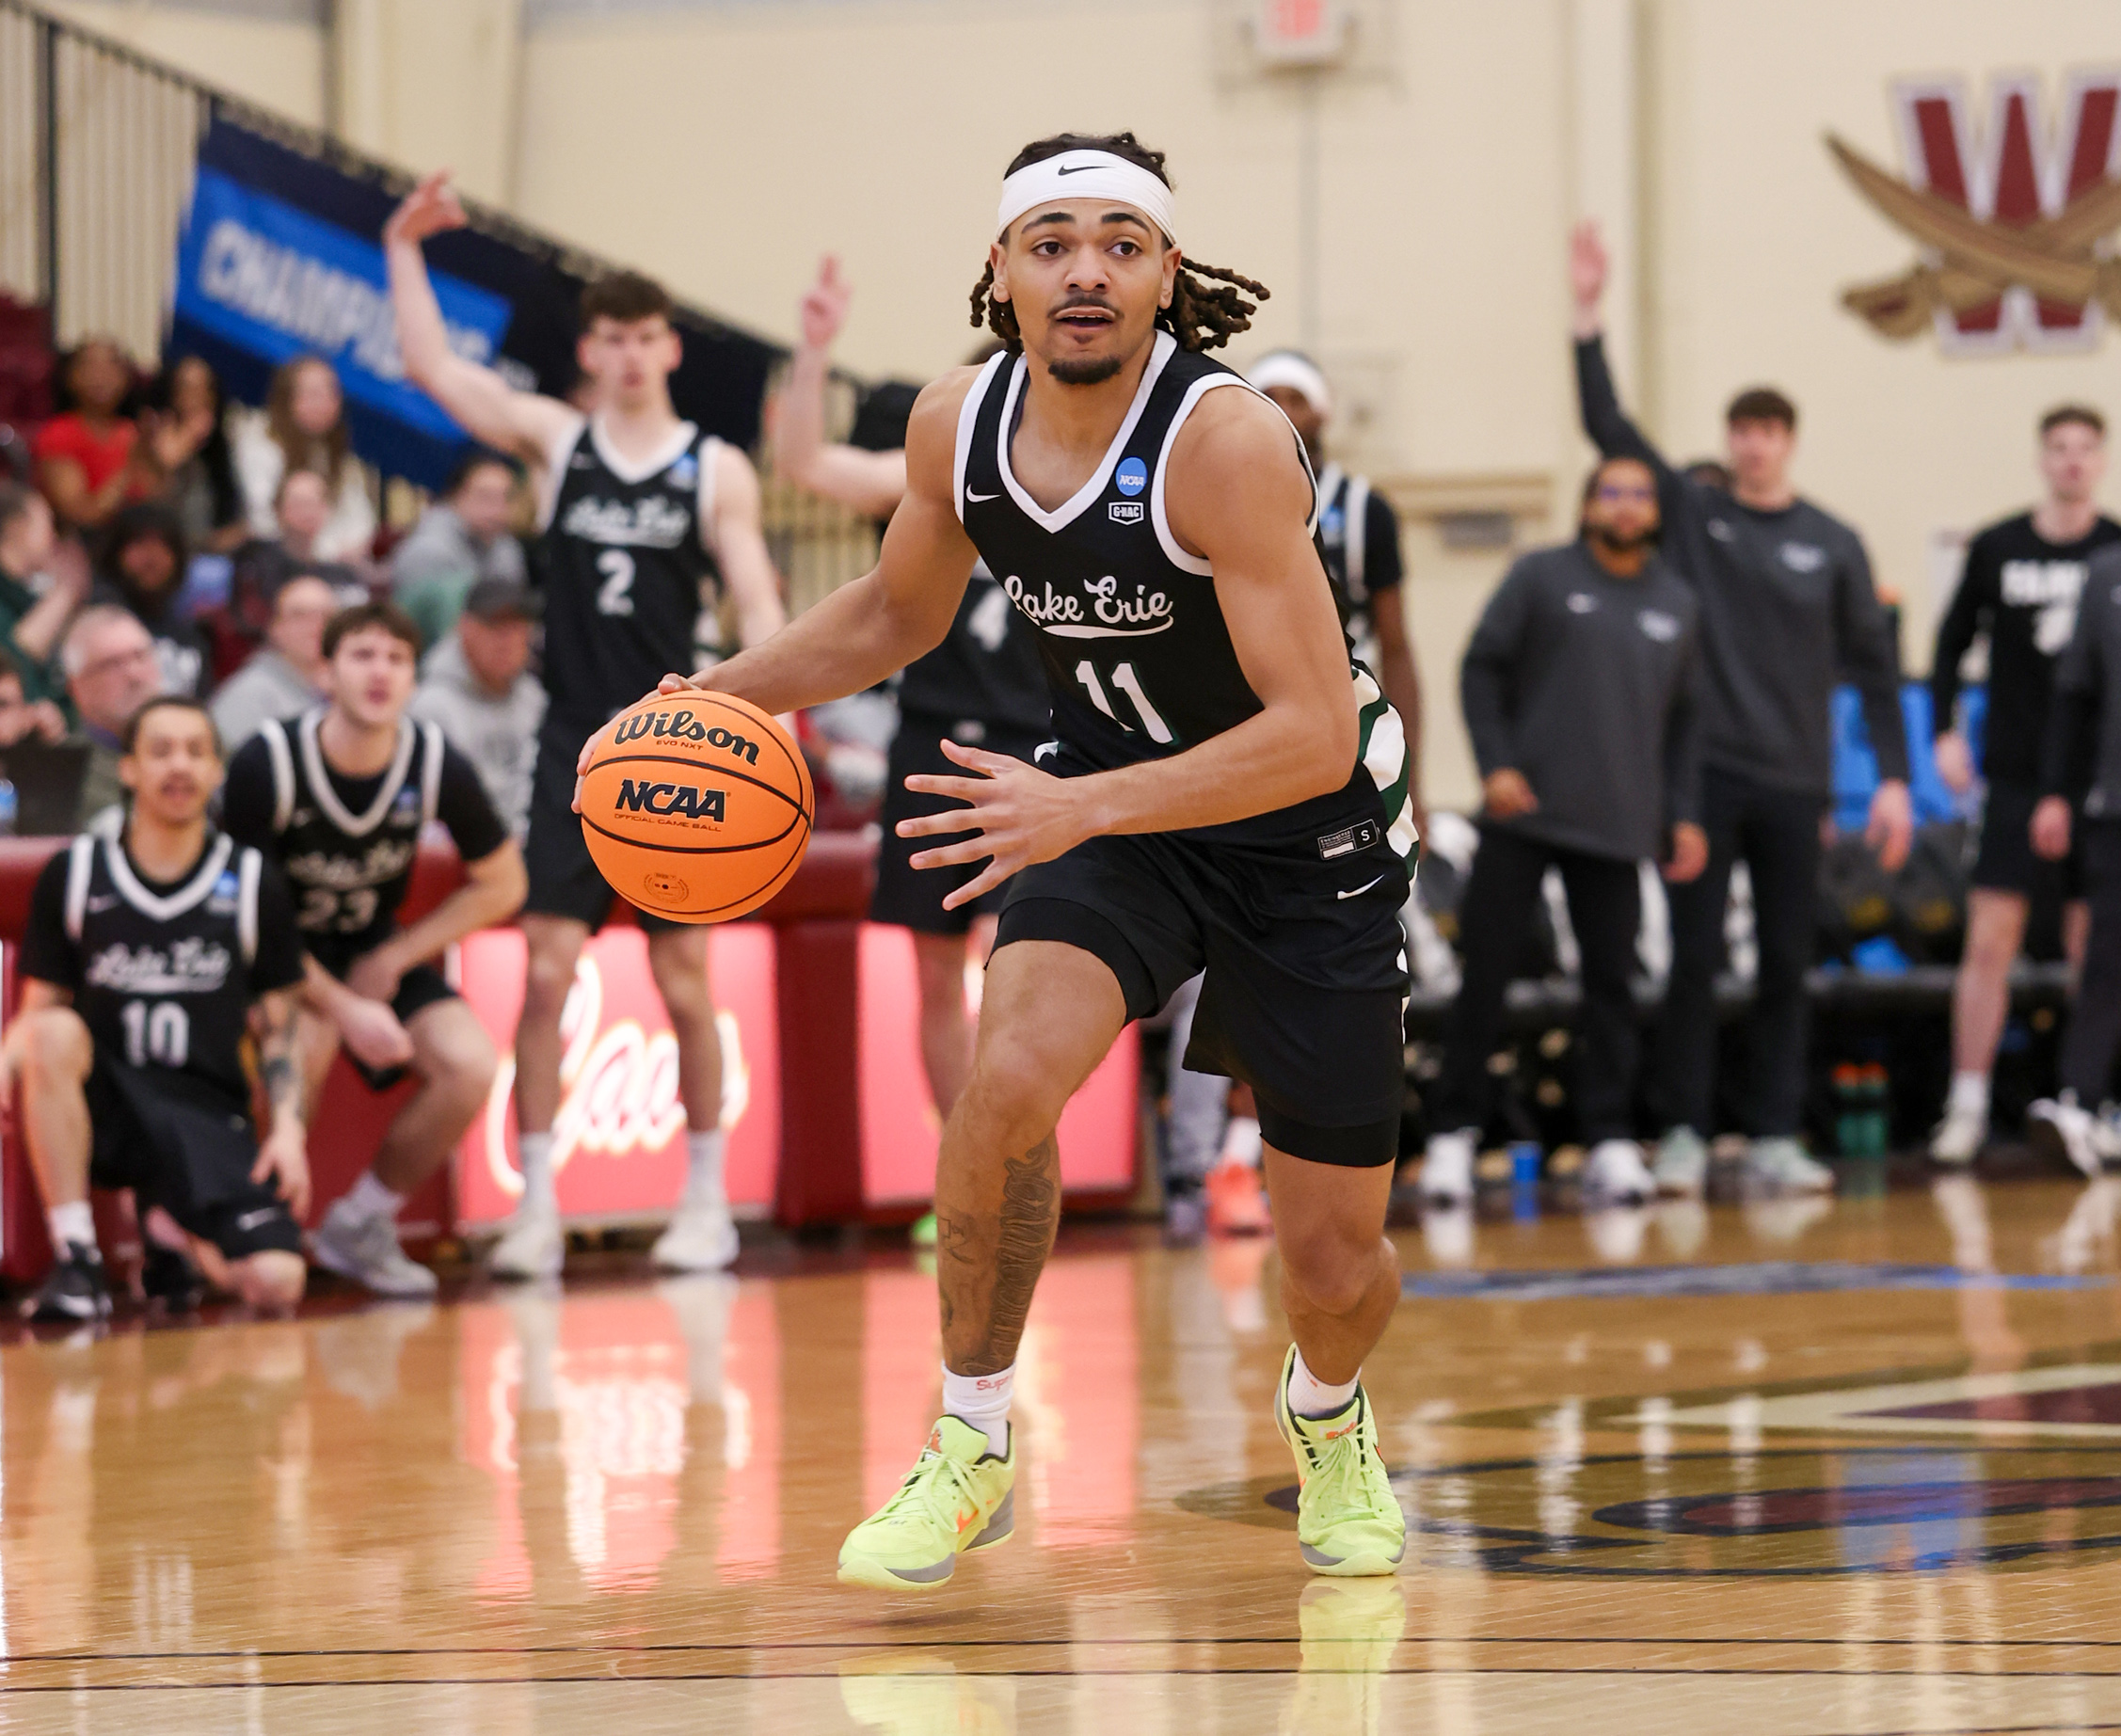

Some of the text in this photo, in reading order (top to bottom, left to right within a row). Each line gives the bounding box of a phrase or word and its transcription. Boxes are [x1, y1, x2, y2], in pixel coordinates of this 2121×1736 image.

[1119, 474, 1145, 486] NCAA
[596, 549, 636, 616] 2
[1004, 575, 1174, 627] Lake Erie
[1075, 660, 1174, 744] 11
[614, 709, 761, 767] Wilson
[680, 741, 704, 751] NXT
[614, 778, 726, 823] NCAA
[614, 813, 722, 833] OFFICIAL GAME BALL
[1360, 829, 1371, 842] S
[295, 888, 378, 934] 23
[122, 999, 189, 1068] 10
